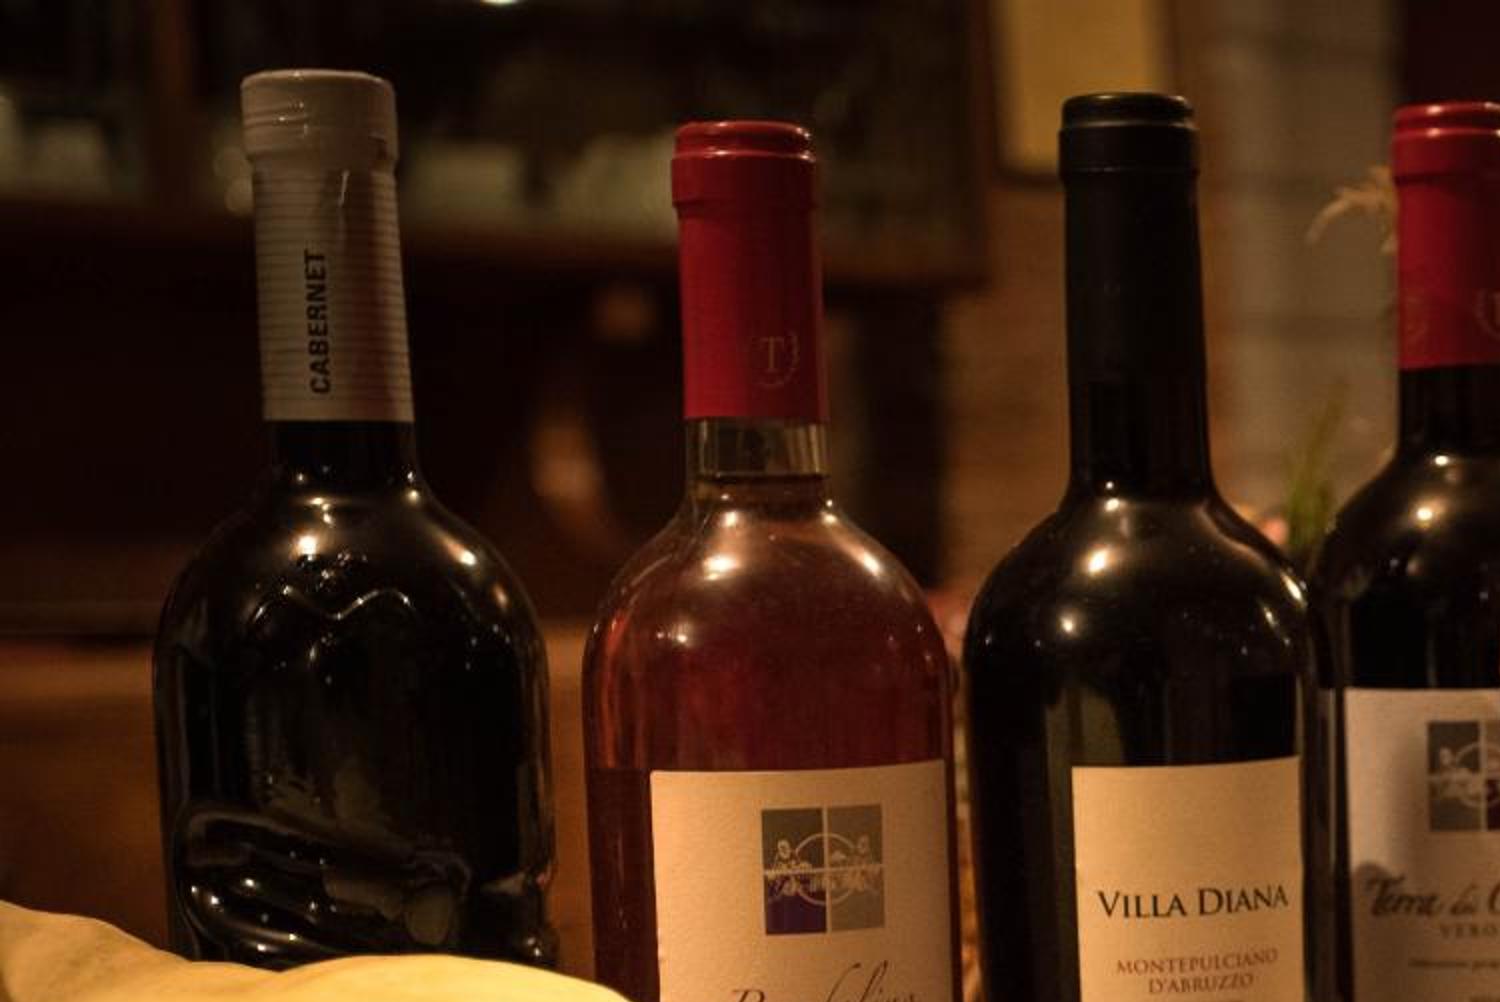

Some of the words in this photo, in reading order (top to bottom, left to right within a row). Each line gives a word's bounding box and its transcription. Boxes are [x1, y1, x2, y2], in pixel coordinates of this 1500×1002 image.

[303, 249, 331, 394] CABERNET
[1097, 890, 1187, 918] VILLA
[1198, 884, 1289, 916] DIANA
[1117, 948, 1279, 974] MONTEPULCIANO
